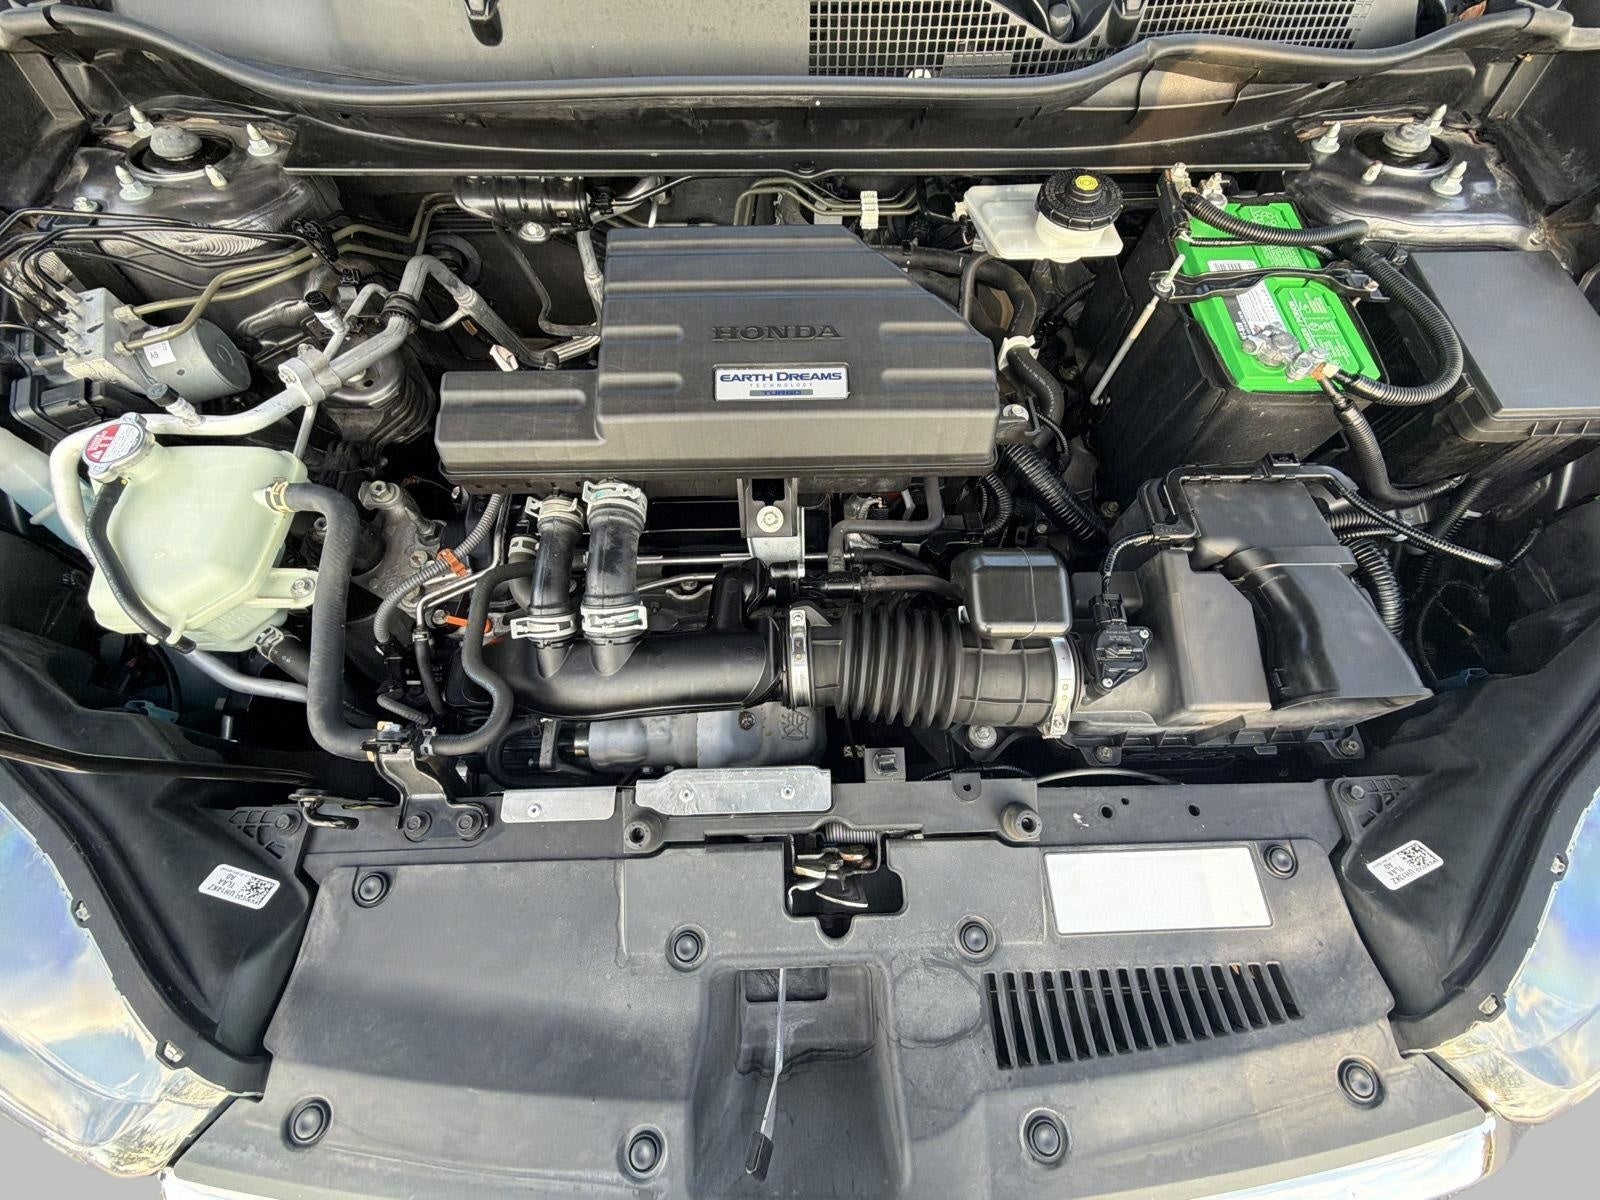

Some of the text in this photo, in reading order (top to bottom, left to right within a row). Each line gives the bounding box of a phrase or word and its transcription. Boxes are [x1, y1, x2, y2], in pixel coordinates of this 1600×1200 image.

[711, 325, 845, 342] HONDA
[720, 371, 842, 382] EARTH DREAMS
